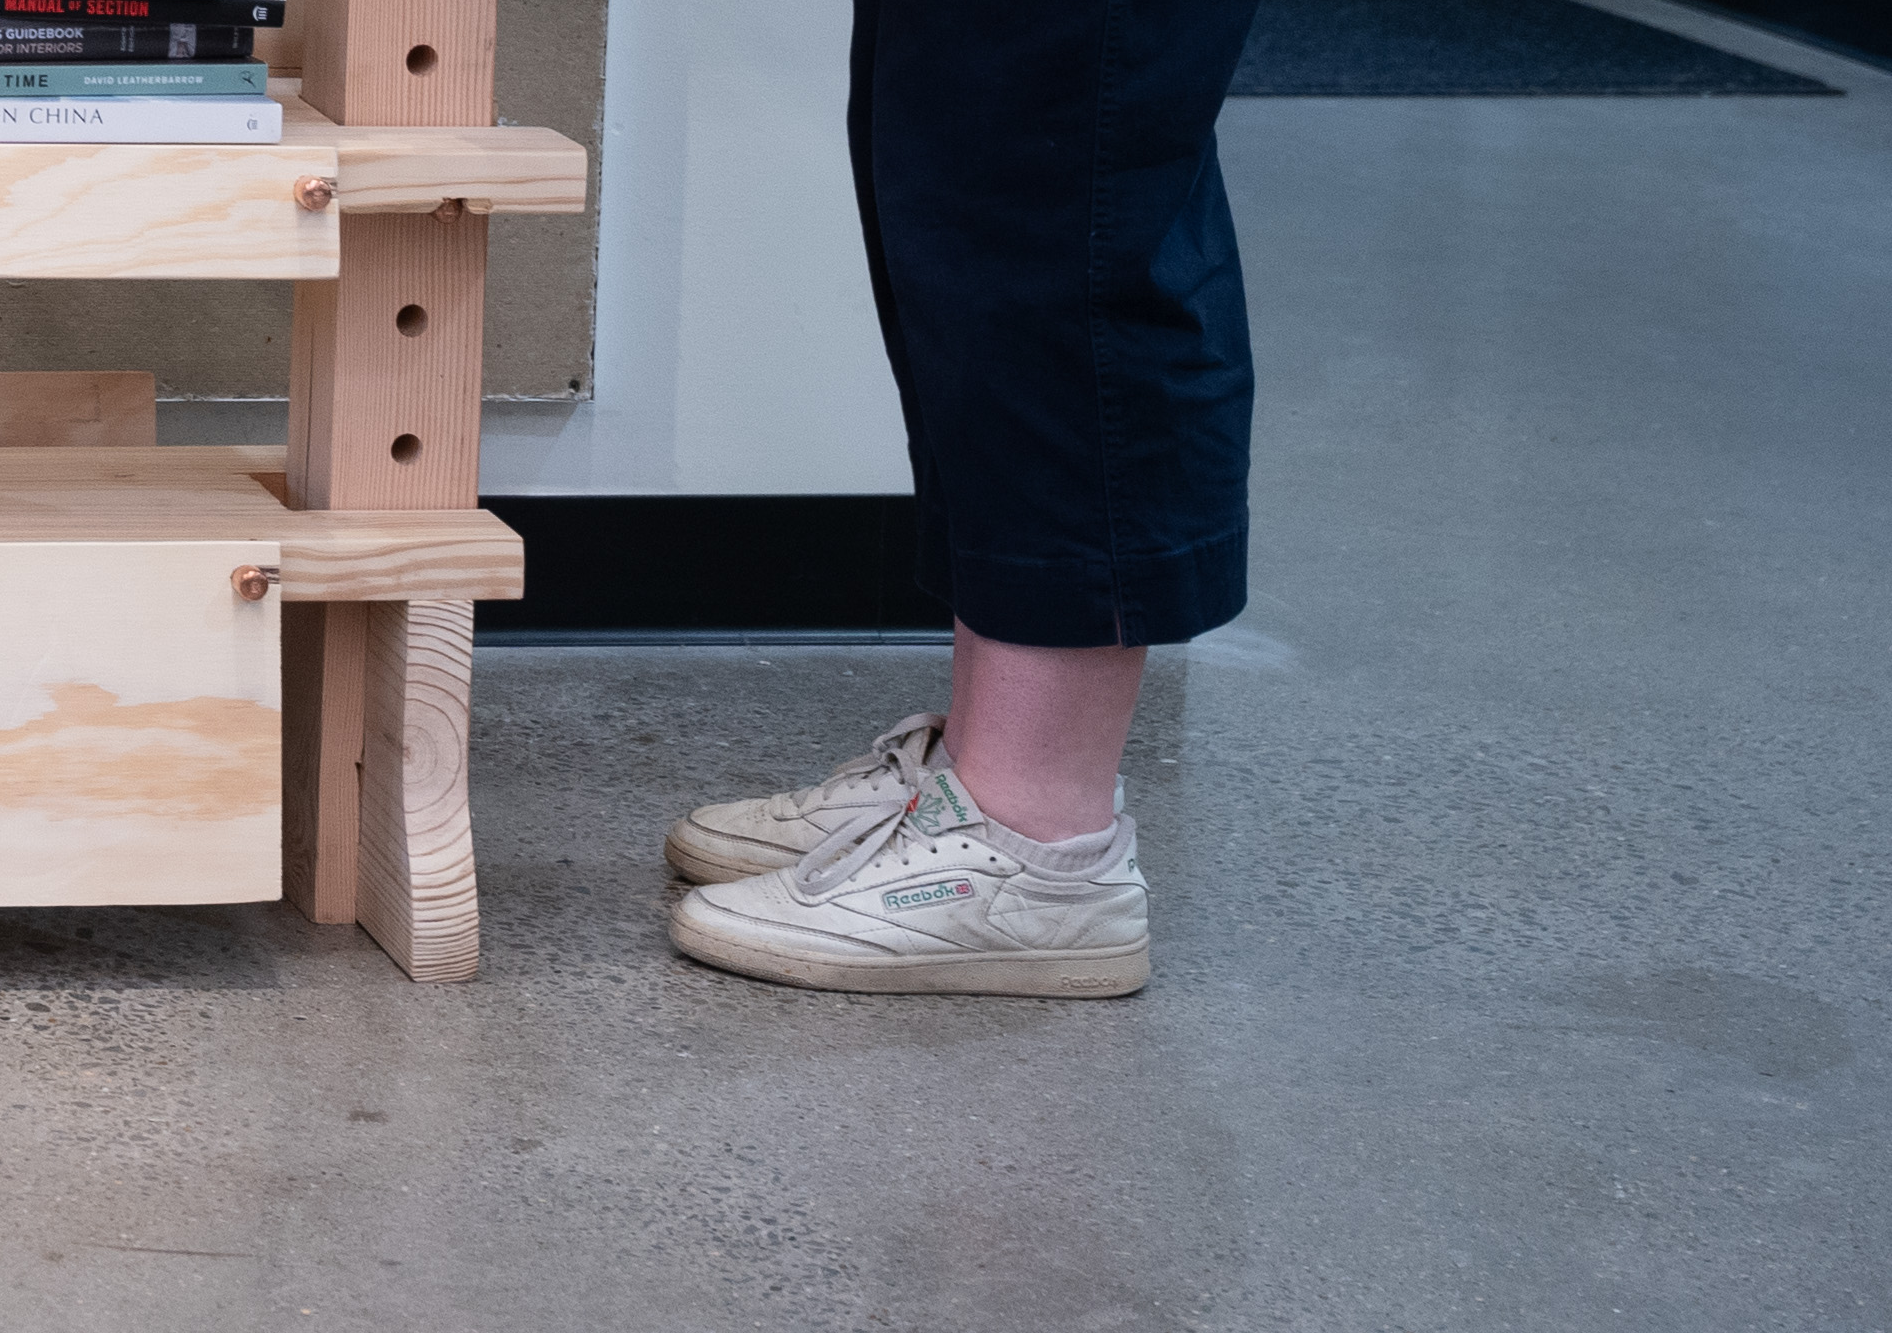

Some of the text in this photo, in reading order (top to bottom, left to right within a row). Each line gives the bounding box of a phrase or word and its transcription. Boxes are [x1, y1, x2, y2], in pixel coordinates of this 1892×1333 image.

[86, 0, 149, 17] SECTION
[5, 28, 84, 40] GUIDEBOOK
[16, 42, 84, 55] INTERIORS
[4, 74, 49, 88] TIME
[83, 76, 115, 85] DAVID
[118, 76, 204, 85] LEATHERBARROW
[29, 108, 105, 125] CHINA
[935, 773, 969, 823] Reebok
[885, 883, 956, 909] Reebok
